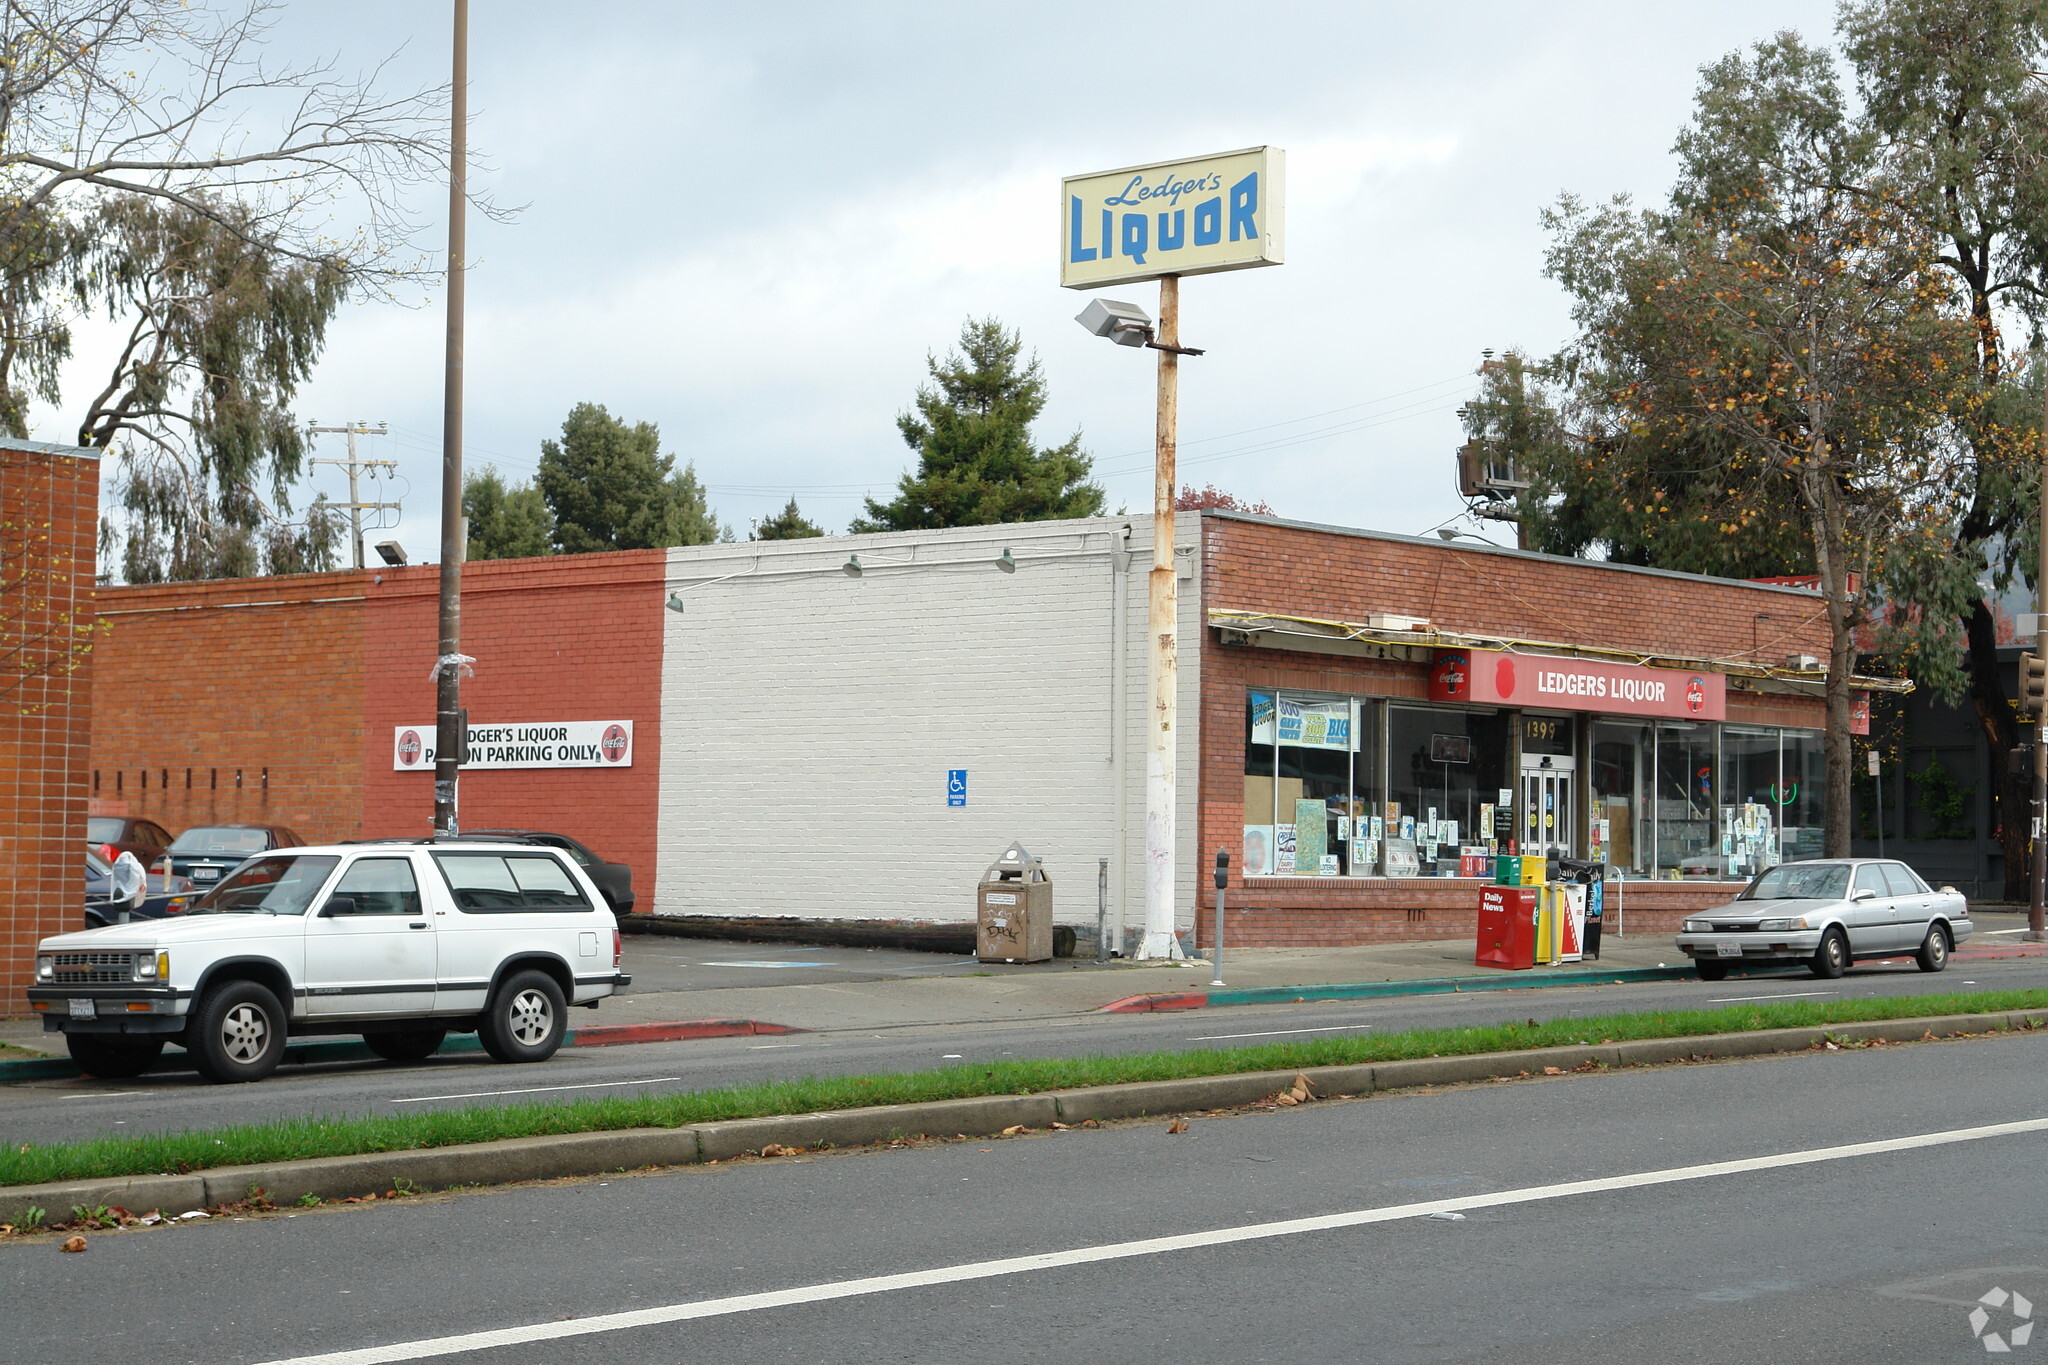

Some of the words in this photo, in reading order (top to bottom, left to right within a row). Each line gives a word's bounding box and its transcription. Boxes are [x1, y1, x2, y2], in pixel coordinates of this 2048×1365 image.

[1104, 172, 1221, 206] Ledger's
[1070, 171, 1258, 265] LIQUOR
[1538, 671, 1607, 697] LEDGERS
[1611, 677, 1666, 702] LIQUOR
[468, 728, 513, 743] DGER'S
[518, 727, 568, 743] LIQUOR
[1306, 723, 1325, 737] 300
[1327, 718, 1349, 737] BIG
[1527, 721, 1556, 740] 1399
[487, 745, 553, 762] PARKING
[558, 744, 598, 761] ONLY
[1482, 902, 1504, 912] News
[1484, 892, 1503, 904] Daily
